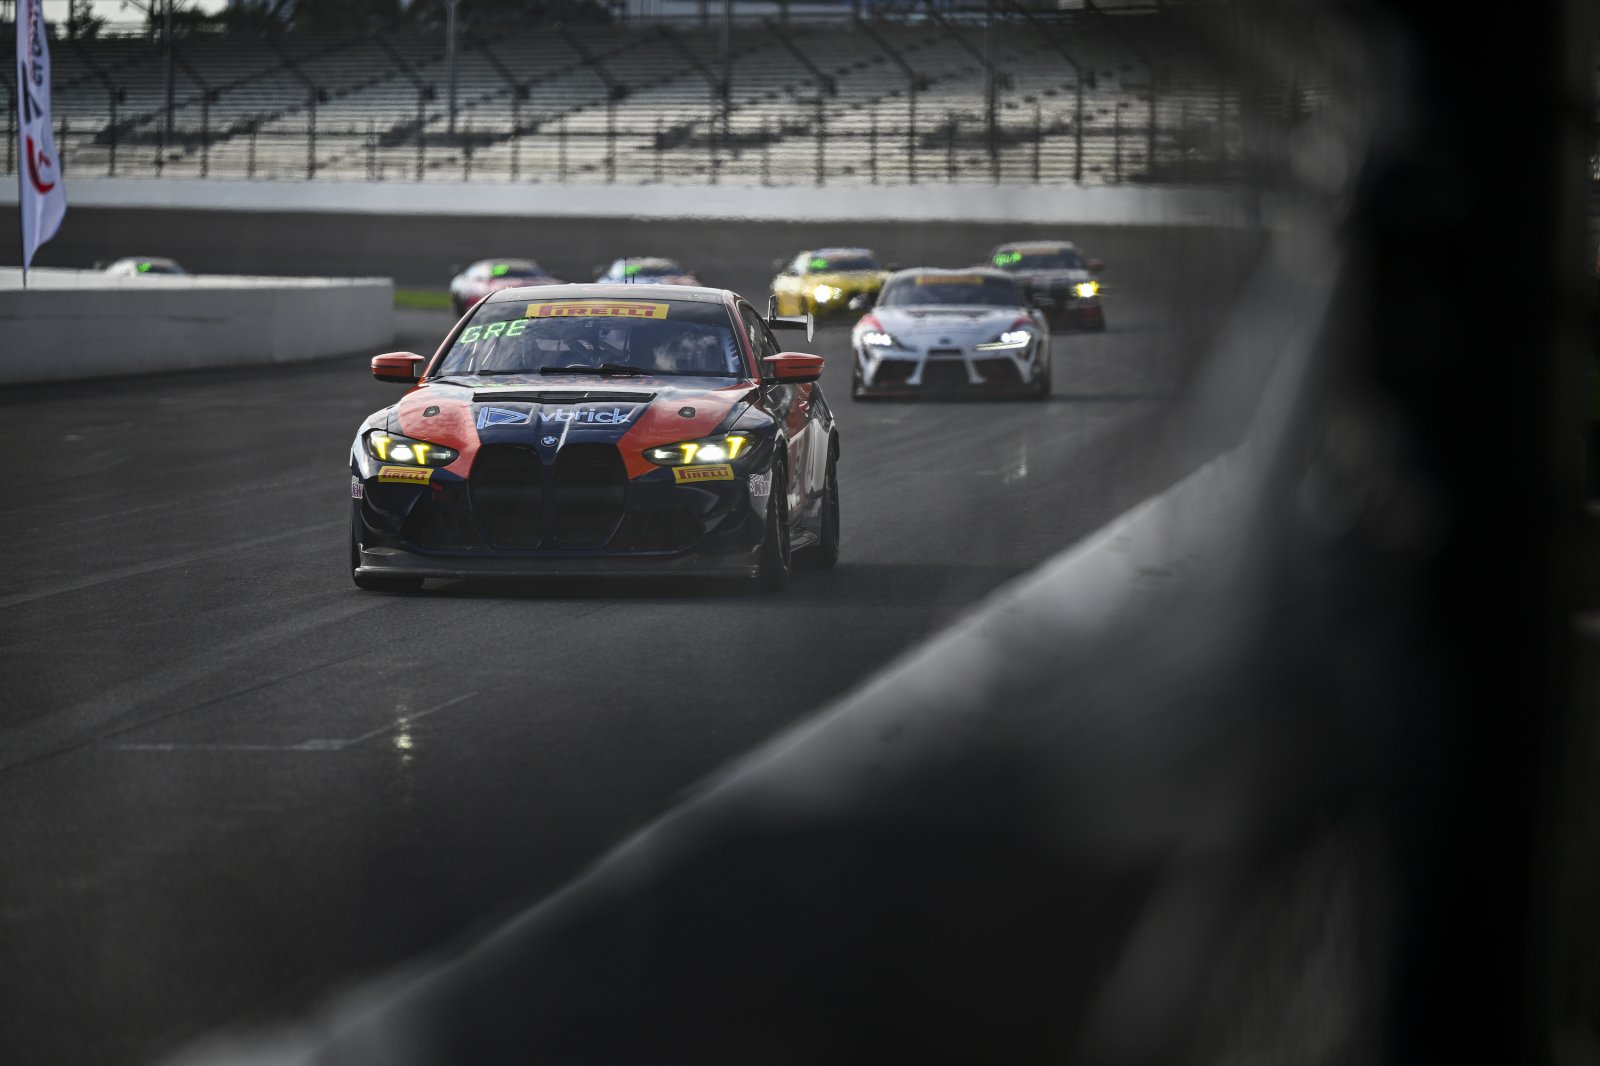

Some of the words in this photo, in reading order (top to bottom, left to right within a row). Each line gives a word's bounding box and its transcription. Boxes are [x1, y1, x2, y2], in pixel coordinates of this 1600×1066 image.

[539, 303, 656, 317] PIRELLI
[460, 318, 529, 344] GRE
[538, 407, 632, 425] vbrick
[382, 469, 428, 480] PIRELLI
[678, 467, 728, 479] PIRELLI
